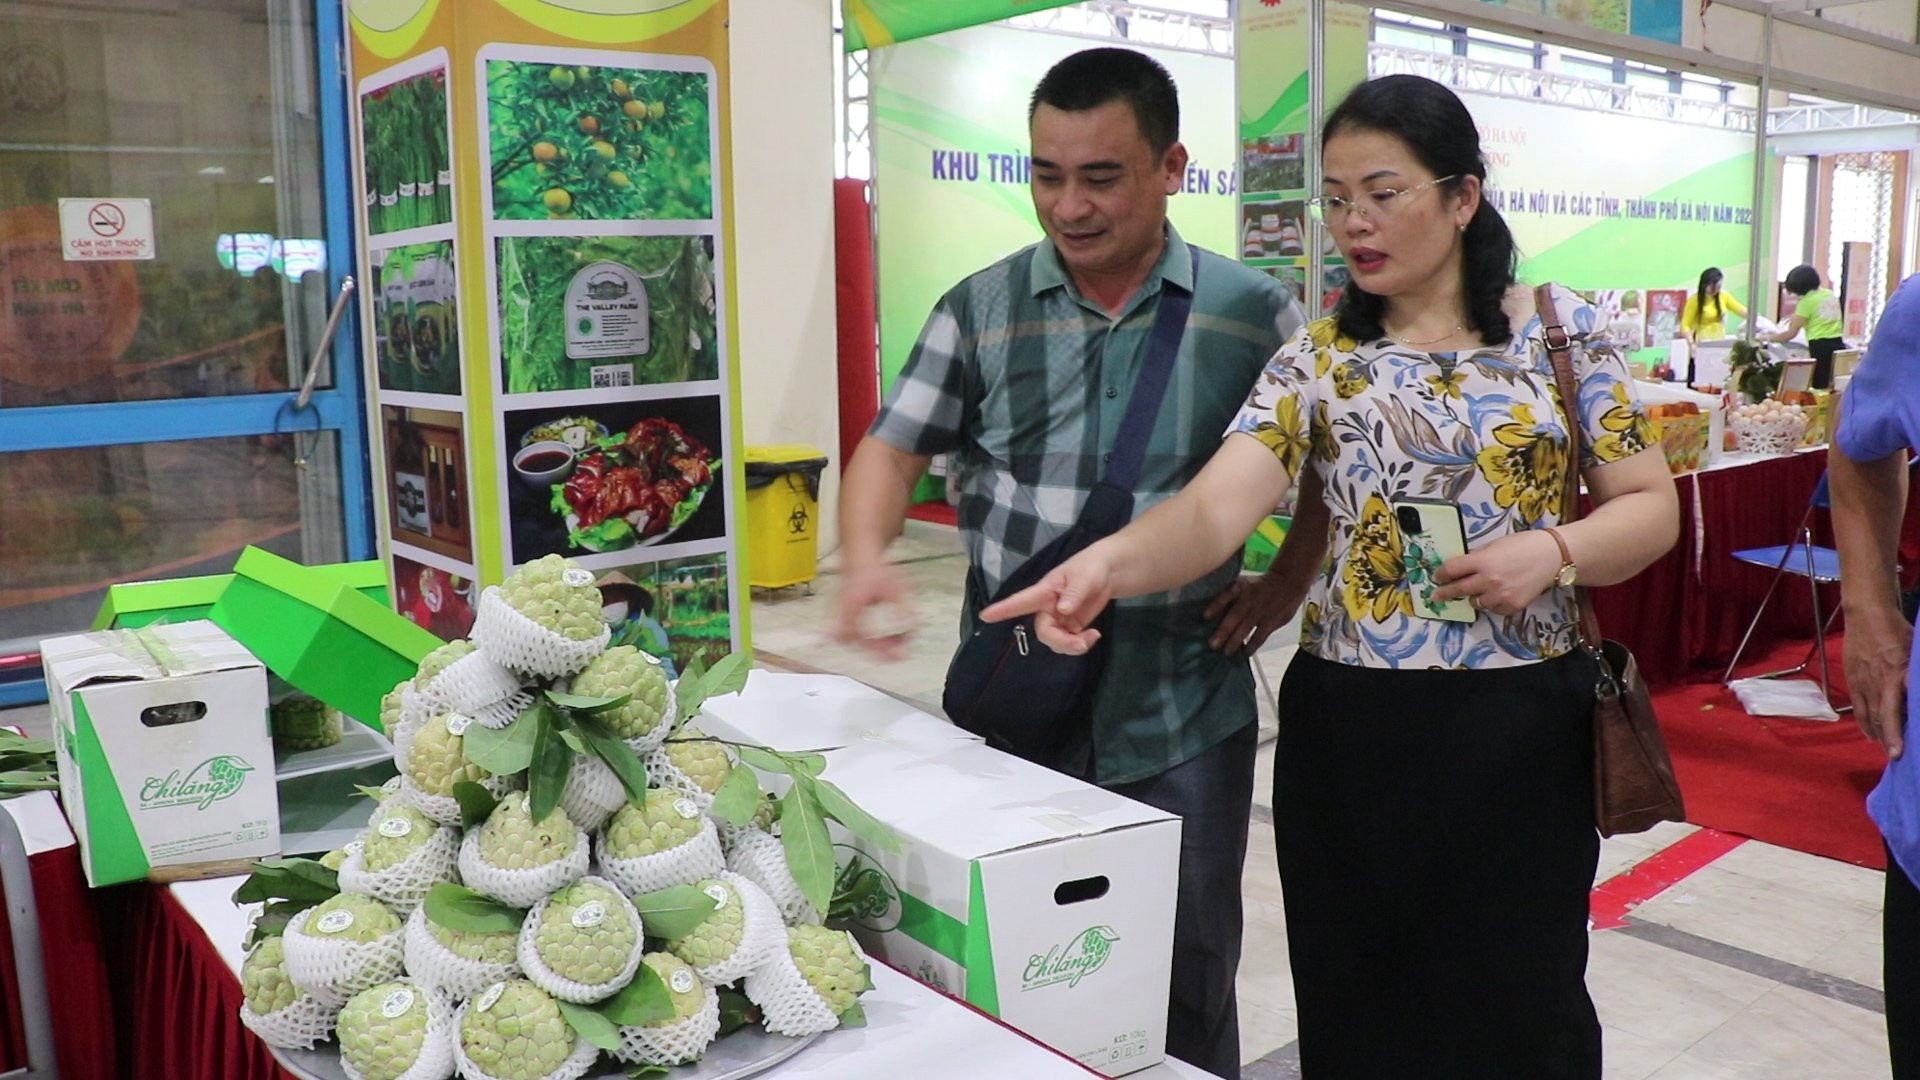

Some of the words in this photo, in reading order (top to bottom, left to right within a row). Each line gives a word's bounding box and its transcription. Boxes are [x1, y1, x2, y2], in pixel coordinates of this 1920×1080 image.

[932, 150, 979, 182] KHU
[987, 148, 1032, 185] TRÌN
[1180, 160, 1210, 195] IẾN
[1217, 162, 1237, 196] SẢ
[1510, 187, 1526, 213] HÀ
[1529, 189, 1550, 219] NỘI
[1553, 190, 1567, 215] VÀ
[1570, 191, 1593, 216] CÁC
[1625, 195, 1657, 219] THÀNH
[1659, 195, 1679, 221] PHỐ
[1681, 200, 1693, 221] HÀ
[1695, 201, 1711, 226] NỘI
